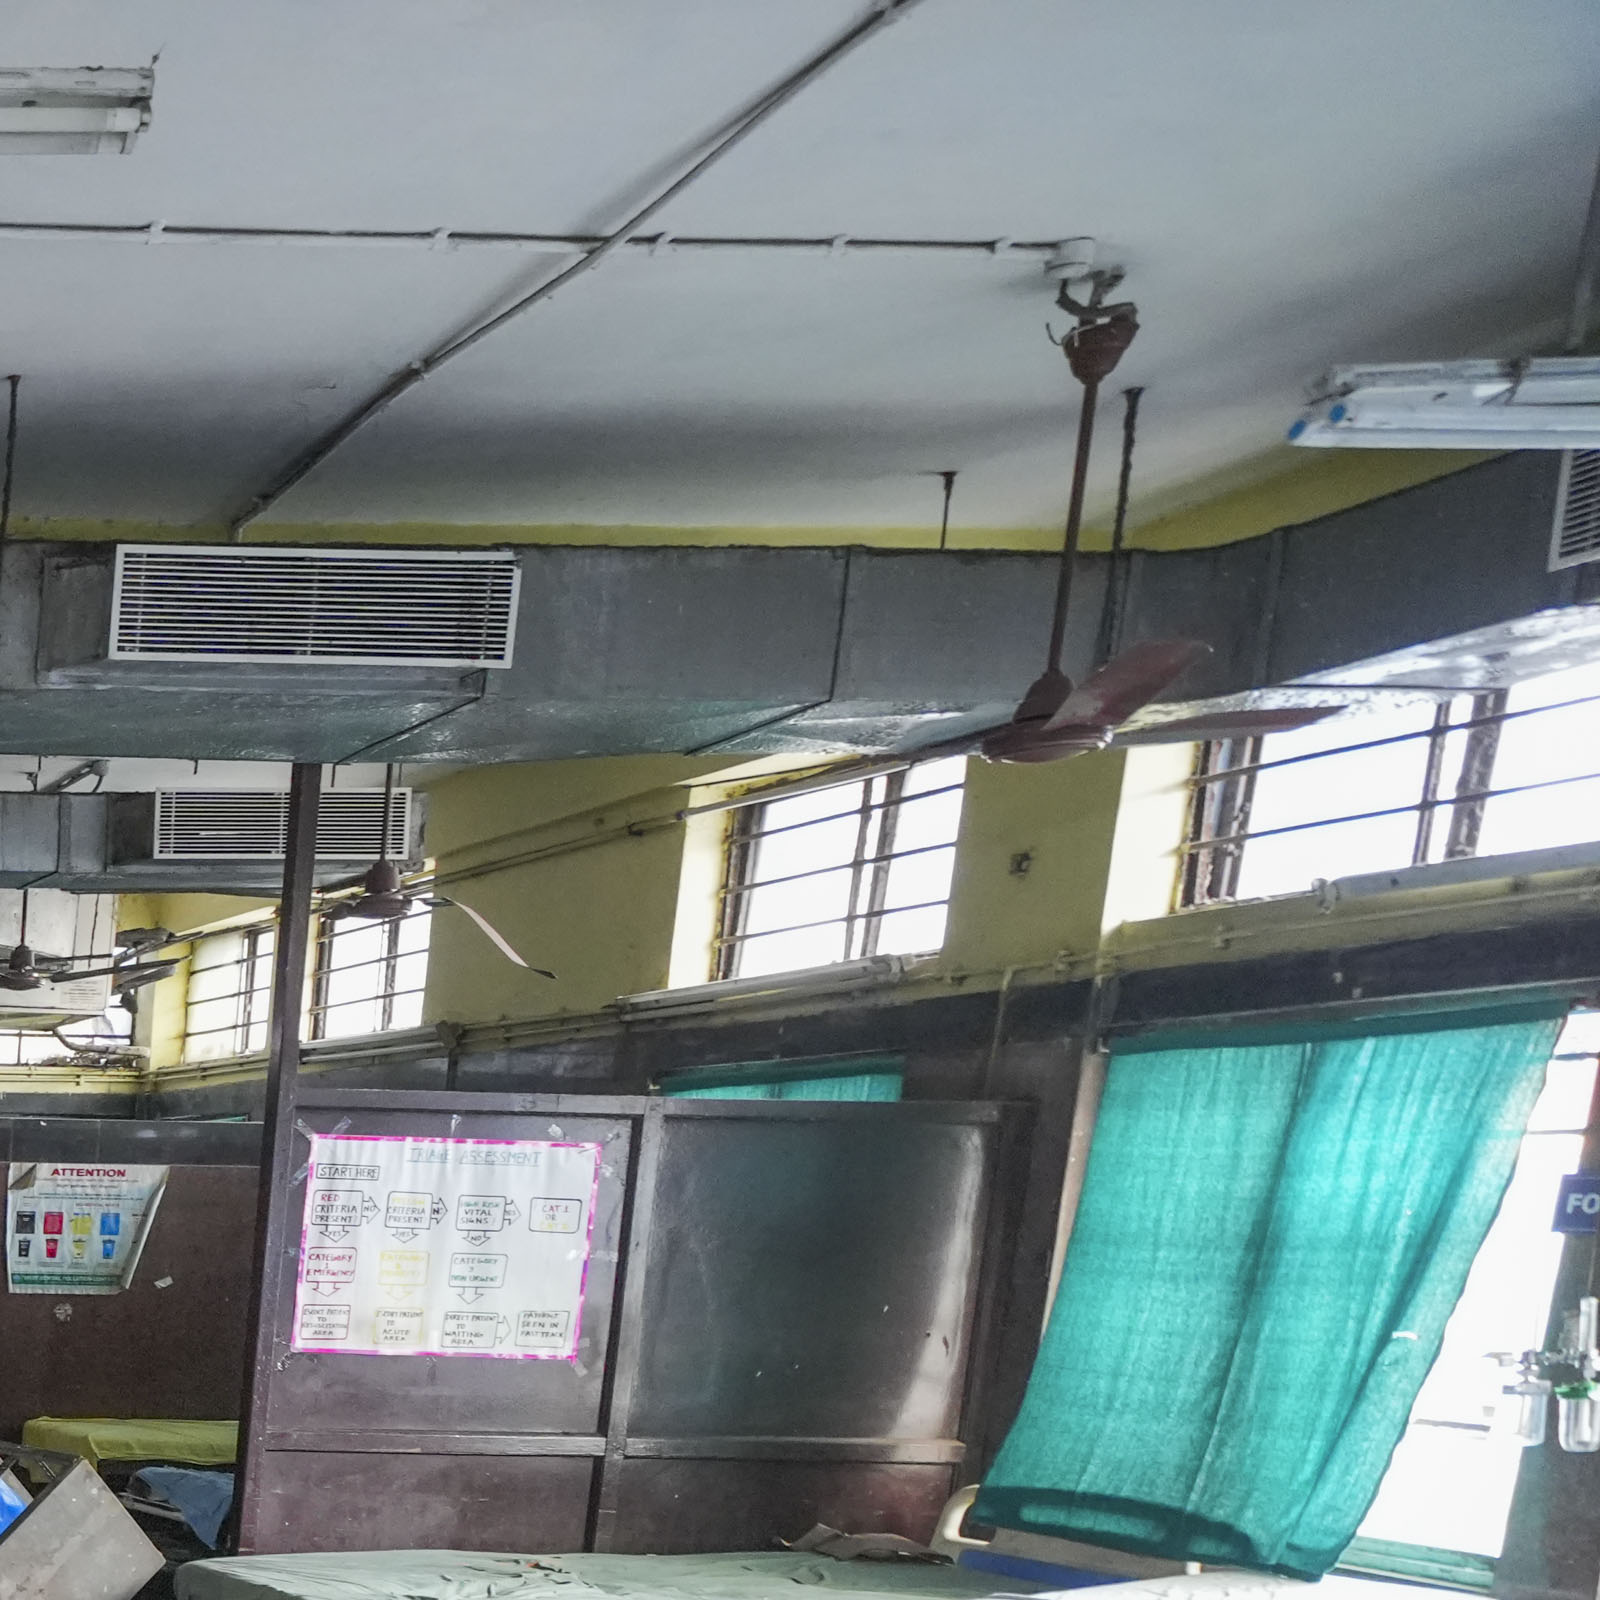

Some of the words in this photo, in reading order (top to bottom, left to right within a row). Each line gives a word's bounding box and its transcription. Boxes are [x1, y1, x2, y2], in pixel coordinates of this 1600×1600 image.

[461, 1152, 541, 1164] ASSESSMENT
[51, 1168, 126, 1177] ATTENTION
[320, 1167, 351, 1177] START
[356, 1168, 378, 1179] HERE
[315, 1205, 357, 1213] CRITERIA
[387, 1207, 425, 1215] CRITERIA
[464, 1208, 492, 1216] VITAL
